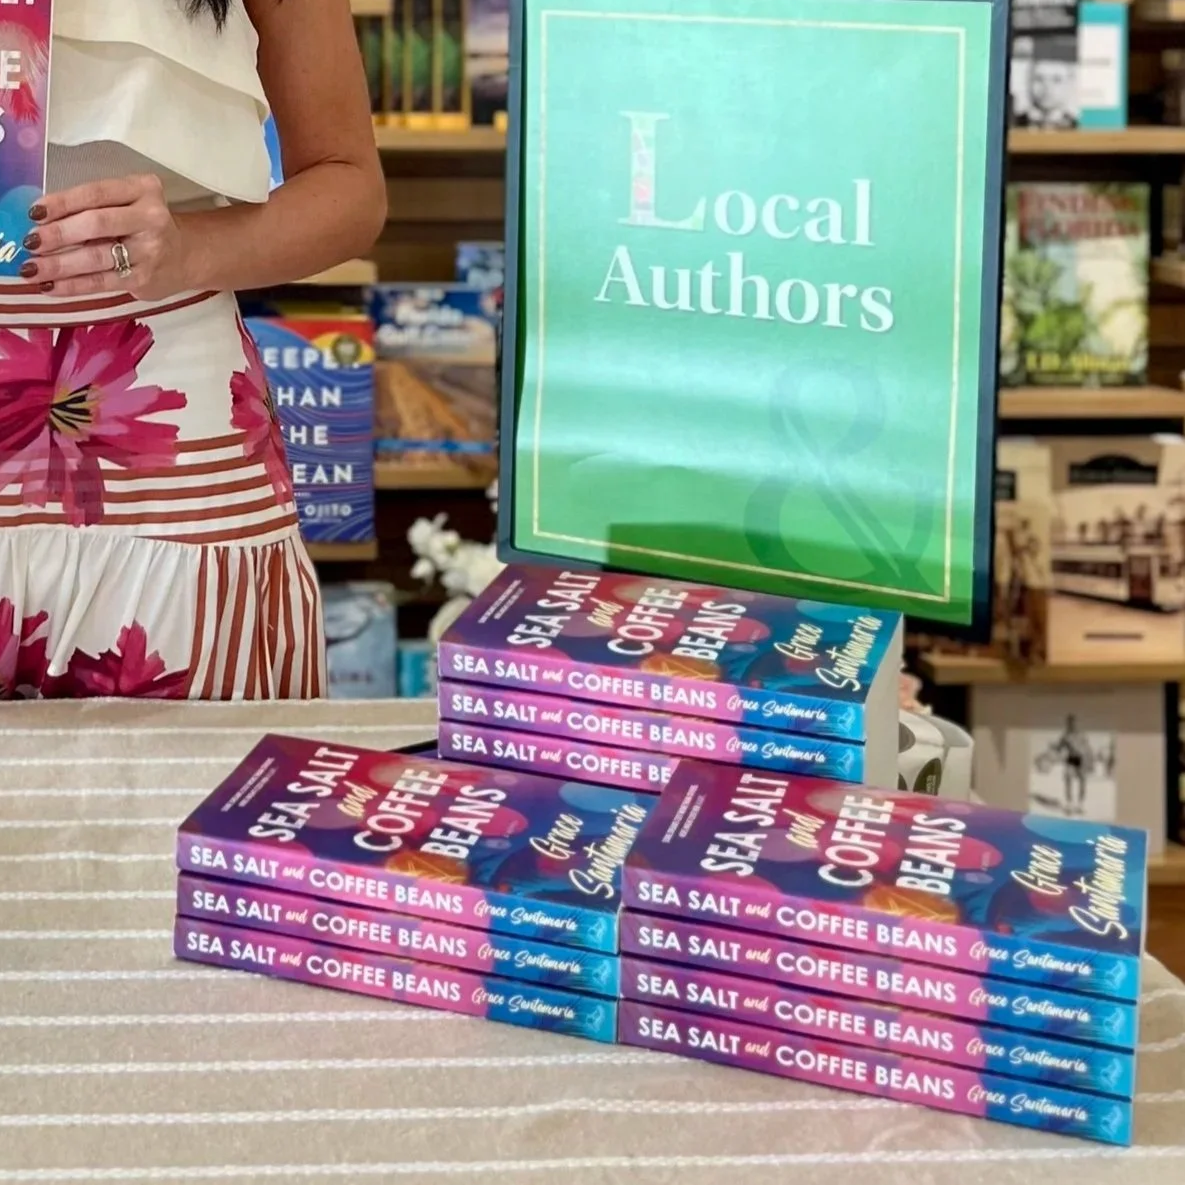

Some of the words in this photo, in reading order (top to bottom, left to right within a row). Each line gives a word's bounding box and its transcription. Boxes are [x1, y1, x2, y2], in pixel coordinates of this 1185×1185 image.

[617, 110, 876, 247] Local
[593, 245, 894, 333] Authors
[276, 386, 343, 408] HAN
[281, 425, 329, 446] HE
[292, 463, 354, 484] EAN
[304, 504, 353, 518] OJITO
[506, 612, 563, 649] SEA
[536, 571, 602, 611] SALT
[586, 598, 624, 628] and
[606, 587, 689, 656] COFFEE
[671, 600, 748, 662] BEANS
[772, 621, 824, 662] Grace
[453, 653, 488, 676] SEA
[495, 659, 539, 682] SALT
[542, 667, 563, 684] and
[568, 670, 644, 701] COFFEE
[650, 684, 717, 709] BEANS
[726, 693, 760, 712] Grace
[761, 700, 827, 721] Santamaria
[814, 614, 884, 692] Santamaria
[451, 733, 487, 756] SEA
[493, 739, 536, 763] SALT
[540, 747, 561, 764] and
[566, 751, 643, 778] COFFEE
[452, 693, 488, 717] SEA
[493, 700, 536, 724] SALT
[541, 707, 562, 724] and
[566, 711, 643, 740] COFFEE
[649, 724, 716, 751] BEANS
[725, 735, 759, 754] Grace
[760, 742, 826, 764] Santamaria
[248, 801, 320, 843] SEA
[286, 747, 360, 798] SALT
[336, 780, 379, 819] and
[352, 767, 450, 852] COFFEE
[420, 785, 508, 860] BEANS
[722, 773, 790, 827] SALT
[782, 807, 826, 849] and
[529, 812, 584, 861] Grace
[568, 801, 648, 899] Santamaria
[700, 832, 768, 878] SEA
[817, 794, 895, 888] COFFEE
[895, 812, 967, 896] BEANS
[1010, 843, 1068, 896] Grace
[190, 846, 227, 870] SEA
[234, 855, 280, 879] SALT
[282, 863, 305, 880] and
[309, 868, 388, 901] COFFEE
[395, 885, 464, 915] BEANS
[473, 898, 509, 920] Grace
[510, 907, 579, 932] Santamaria
[1068, 833, 1129, 940] Santamaria
[192, 890, 229, 914] SEA
[235, 898, 282, 922] SALT
[285, 907, 308, 925] and
[312, 912, 392, 943] COFFEE
[398, 929, 468, 958] BEANS
[477, 942, 511, 962] Grace
[513, 950, 582, 975] Santamaria
[637, 882, 681, 907] SEA
[688, 890, 741, 918] SALT
[745, 902, 771, 919] and
[776, 906, 868, 941] COFFEE
[876, 923, 958, 957] BEANS
[969, 940, 1009, 961] Grace
[1012, 949, 1092, 977] Santamaria
[187, 932, 224, 956] SEA
[229, 940, 276, 966] SALT
[279, 951, 302, 967] and
[306, 954, 386, 987] COFFEE
[392, 973, 461, 1003] BEANS
[470, 987, 505, 1006] Grace
[508, 994, 575, 1020] Santamaria
[638, 926, 681, 952] SEA
[688, 935, 741, 962] SALT
[745, 947, 771, 964] and
[776, 952, 868, 986] COFFEE
[875, 969, 957, 1004] BEANS
[968, 987, 1008, 1008] Grace
[1011, 995, 1092, 1024] Santamaria
[637, 974, 680, 1000] SEA
[686, 982, 739, 1011] SALT
[743, 995, 770, 1012] and
[774, 1000, 866, 1036] COFFEE
[873, 1018, 954, 1053] BEANS
[965, 1037, 1006, 1058] Grace
[1008, 1046, 1088, 1074] Santamaria
[638, 1016, 681, 1043] SEA
[687, 1026, 740, 1056] SALT
[744, 1040, 771, 1057] and
[775, 1045, 867, 1082] COFFEE
[874, 1064, 955, 1101] BEANS
[966, 1084, 1006, 1105] Grace
[1009, 1092, 1089, 1122] Santamaria
